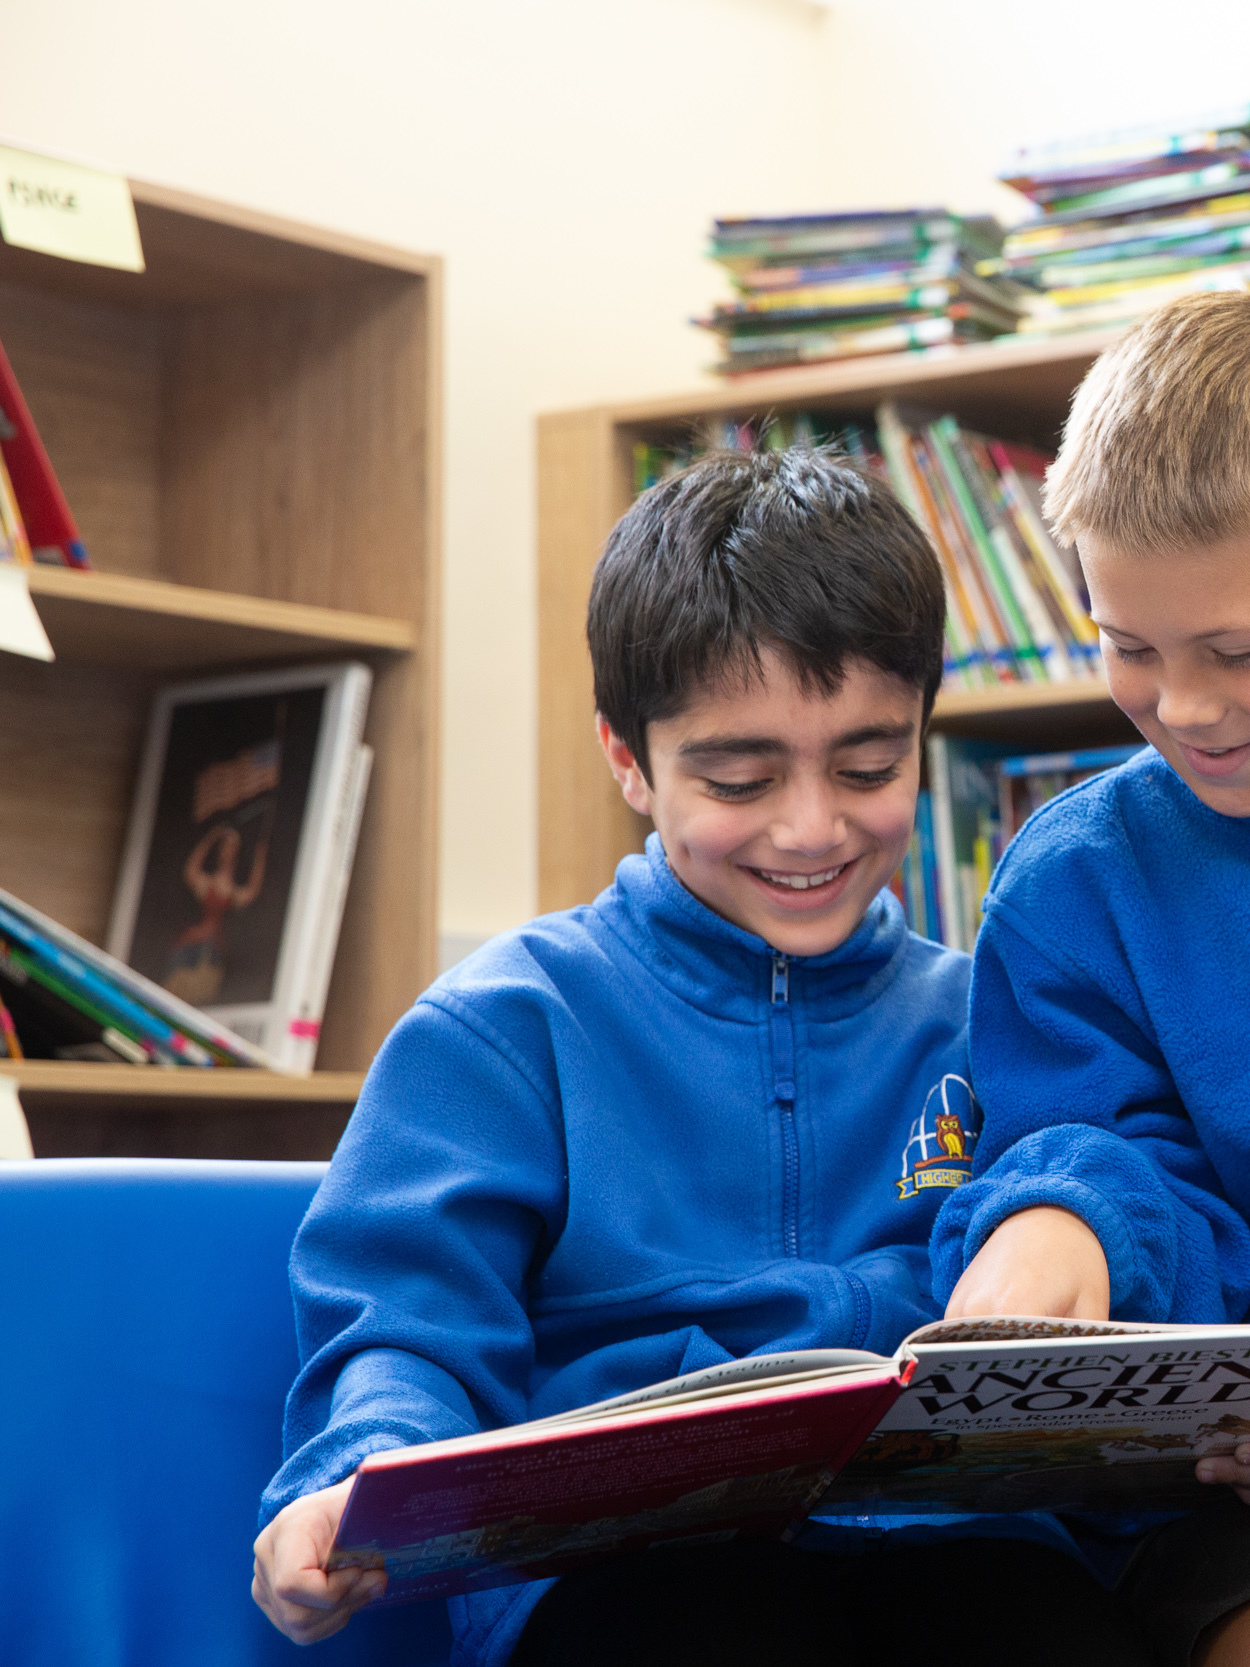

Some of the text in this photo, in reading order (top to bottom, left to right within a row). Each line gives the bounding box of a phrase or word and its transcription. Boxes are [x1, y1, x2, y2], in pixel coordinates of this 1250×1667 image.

[921, 1171, 962, 1184] HIGHER
[936, 1354, 1130, 1373] STEPHEN
[931, 1408, 1208, 1427] Egypt Rome Greece
[970, 1420, 1073, 1430] spectacular
[1085, 1416, 1191, 1426] cross-section
